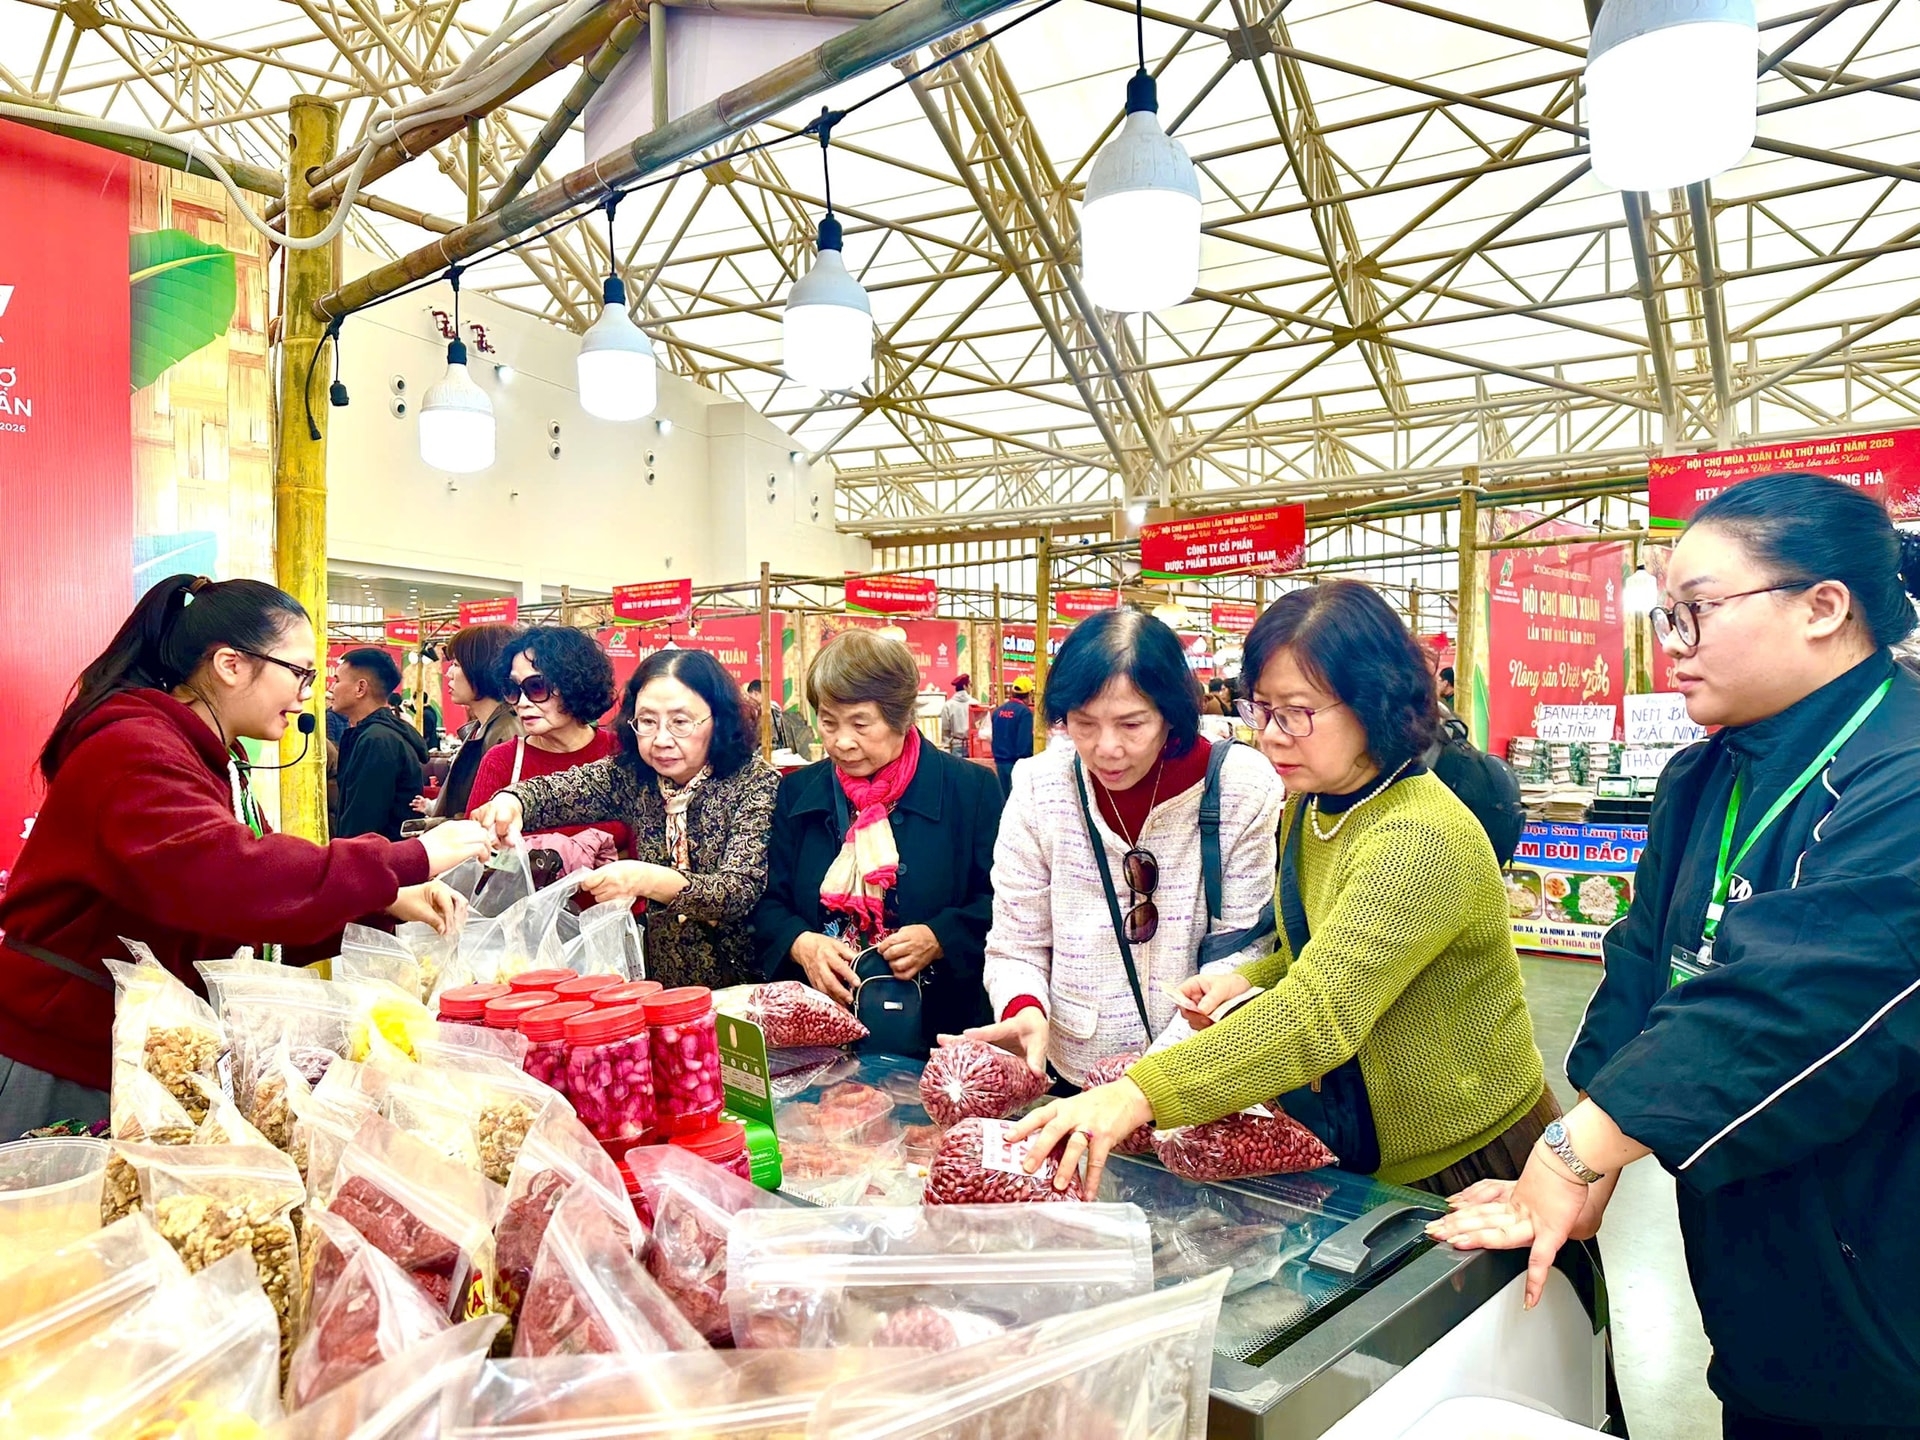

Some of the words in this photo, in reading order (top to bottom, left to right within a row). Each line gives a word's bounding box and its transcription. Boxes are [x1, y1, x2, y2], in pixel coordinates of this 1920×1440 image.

[1686, 458, 1702, 470] HỘI
[1703, 457, 1722, 468] CHỢ
[1724, 454, 1745, 465] MÙA
[1747, 451, 1772, 463] XUÂN
[1774, 447, 1793, 458] LẦN
[1795, 444, 1814, 456] THỨ
[1815, 440, 1842, 455] NHẤT
[1843, 440, 1867, 452] NĂM
[1869, 438, 1895, 449] 2026
[1864, 468, 1885, 485] HÀ
[1695, 486, 1720, 501] HTX
[1186, 544, 1208, 556] CÔNG
[1208, 543, 1218, 553] TY
[1219, 538, 1230, 552] CỔ
[1231, 537, 1254, 551] PHẦN
[1164, 559, 1185, 573] DƯỢC
[1185, 554, 1208, 569] PHẨM
[1208, 553, 1239, 567] TAKICHI
[1239, 551, 1256, 566] VIỆT
[1257, 550, 1277, 562] NAM
[1523, 583, 1538, 620] HỘI
[1540, 590, 1558, 622] CHỢ
[1559, 590, 1578, 619] MÙA
[1579, 594, 1600, 622] XUÂN
[1509, 659, 1542, 697] Nông
[1541, 665, 1558, 688] sản
[1558, 662, 1580, 692] Việt
[1545, 841, 1579, 859] BÙI
[1585, 841, 1626, 861] BẮC
